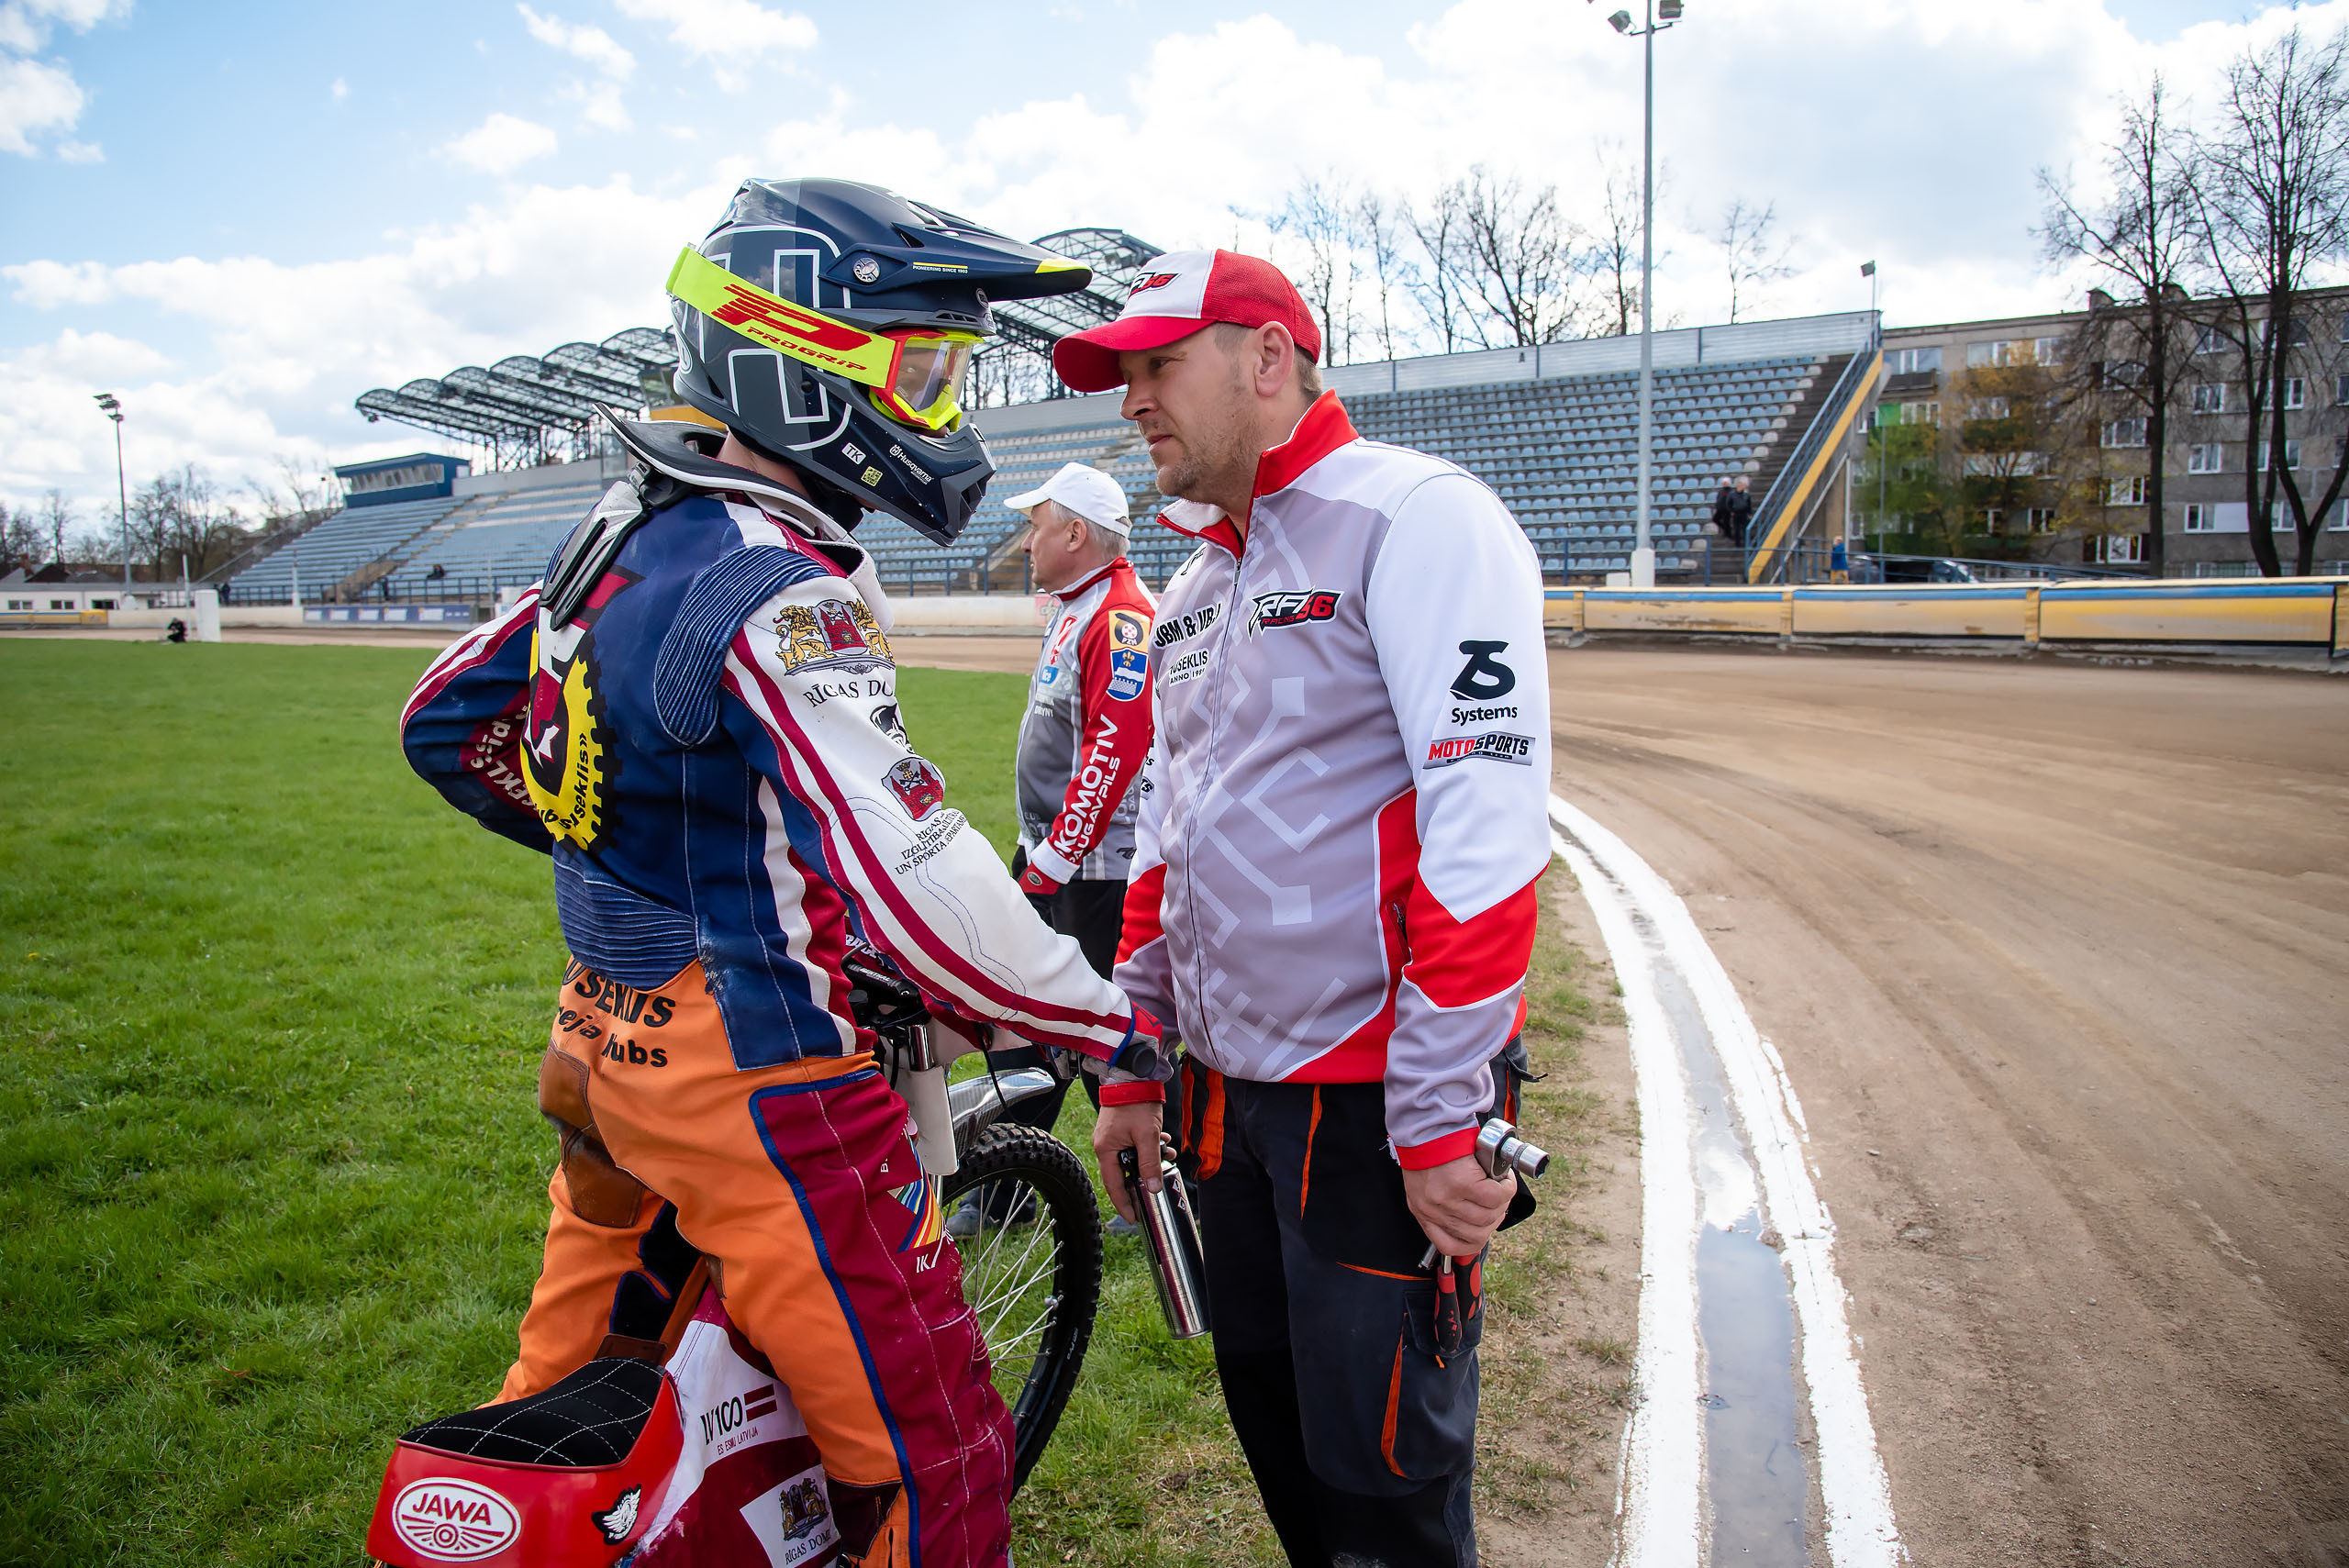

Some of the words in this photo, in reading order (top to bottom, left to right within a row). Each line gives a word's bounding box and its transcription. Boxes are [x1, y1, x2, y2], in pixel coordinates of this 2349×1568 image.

[746, 326, 867, 371] PROGRIP
[846, 445, 863, 462] TK
[897, 451, 933, 483] Husqvarna
[1154, 619, 1184, 648] JBM
[1183, 615, 1197, 638] &
[1261, 615, 1295, 625] RACING
[1170, 671, 1189, 685] ANNO
[803, 681, 859, 707] RĪGAS
[1451, 706, 1519, 727] Systems
[1427, 733, 1530, 761] MOTOSPORTS
[1053, 713, 1119, 857] KOMOTIV
[895, 861, 912, 875] UN
[912, 840, 947, 867] SPORTA
[717, 1443, 724, 1455] ES
[737, 1426, 759, 1445] LATVIJA
[412, 1493, 492, 1526] JAWA
